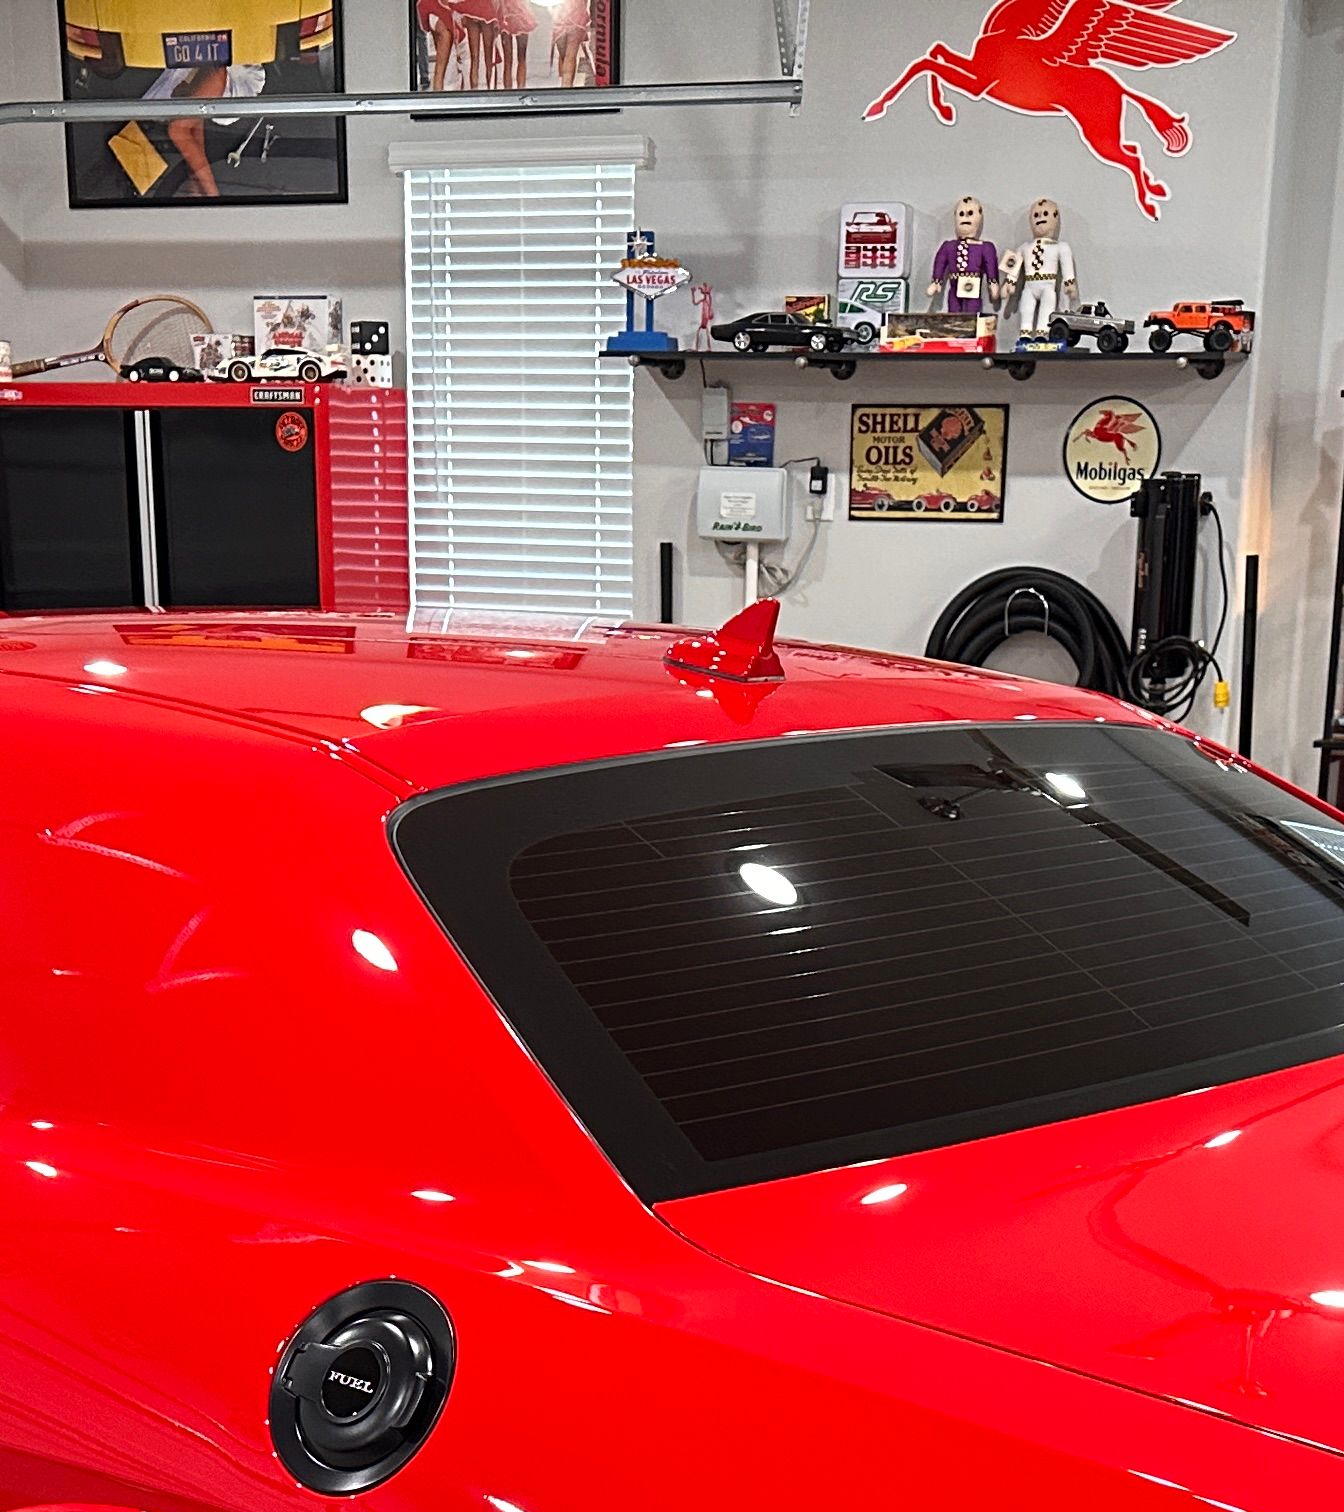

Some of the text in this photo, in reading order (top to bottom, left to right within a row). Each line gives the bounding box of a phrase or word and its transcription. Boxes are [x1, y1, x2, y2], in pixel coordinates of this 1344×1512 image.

[596, 0, 607, 77] ormula
[175, 45, 190, 62] GO
[627, 275, 675, 286] LAS VEGAS
[254, 391, 301, 400] CRAFTSMAN
[857, 413, 922, 434] SHELL
[865, 446, 914, 465] OILS
[1076, 462, 1145, 485] Mobilgas
[328, 1370, 373, 1393] FUEL
